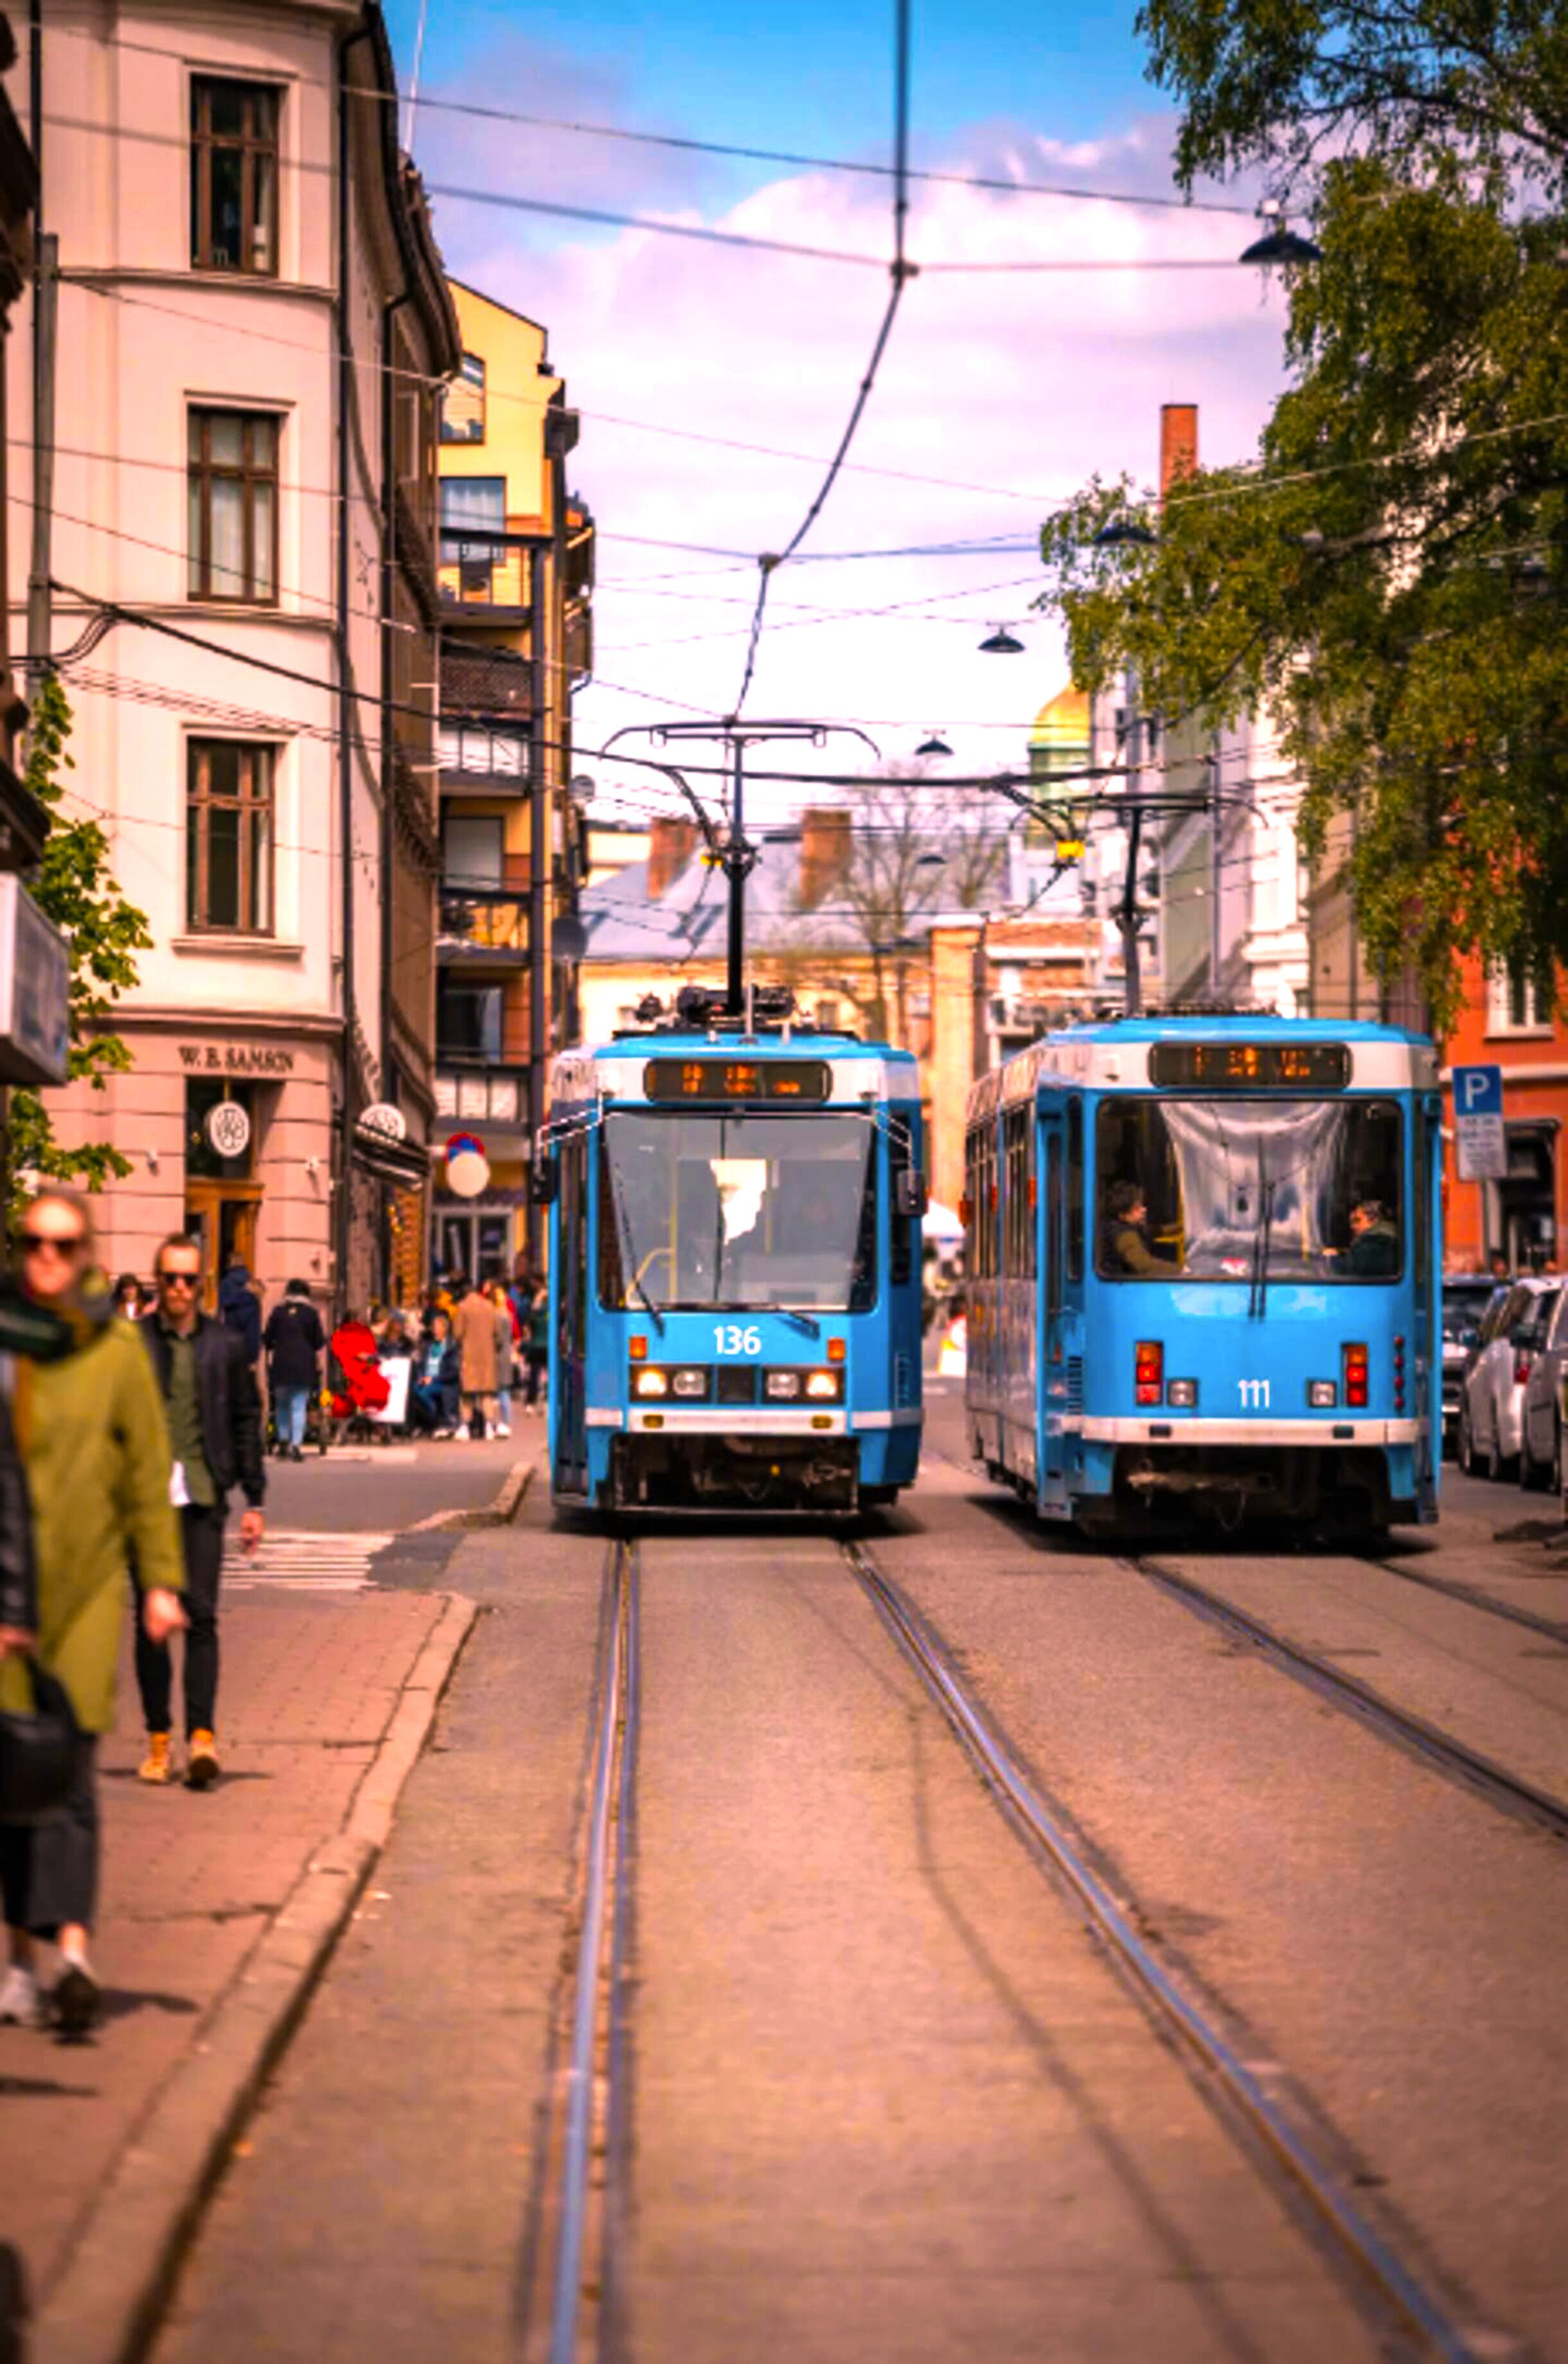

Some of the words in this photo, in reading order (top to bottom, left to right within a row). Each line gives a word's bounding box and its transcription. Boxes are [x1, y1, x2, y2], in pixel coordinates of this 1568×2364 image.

[226, 1047, 293, 1072] SAMSON
[1465, 1073, 1490, 1108] P
[715, 1325, 762, 1355] 136
[1238, 1379, 1270, 1407] 111
